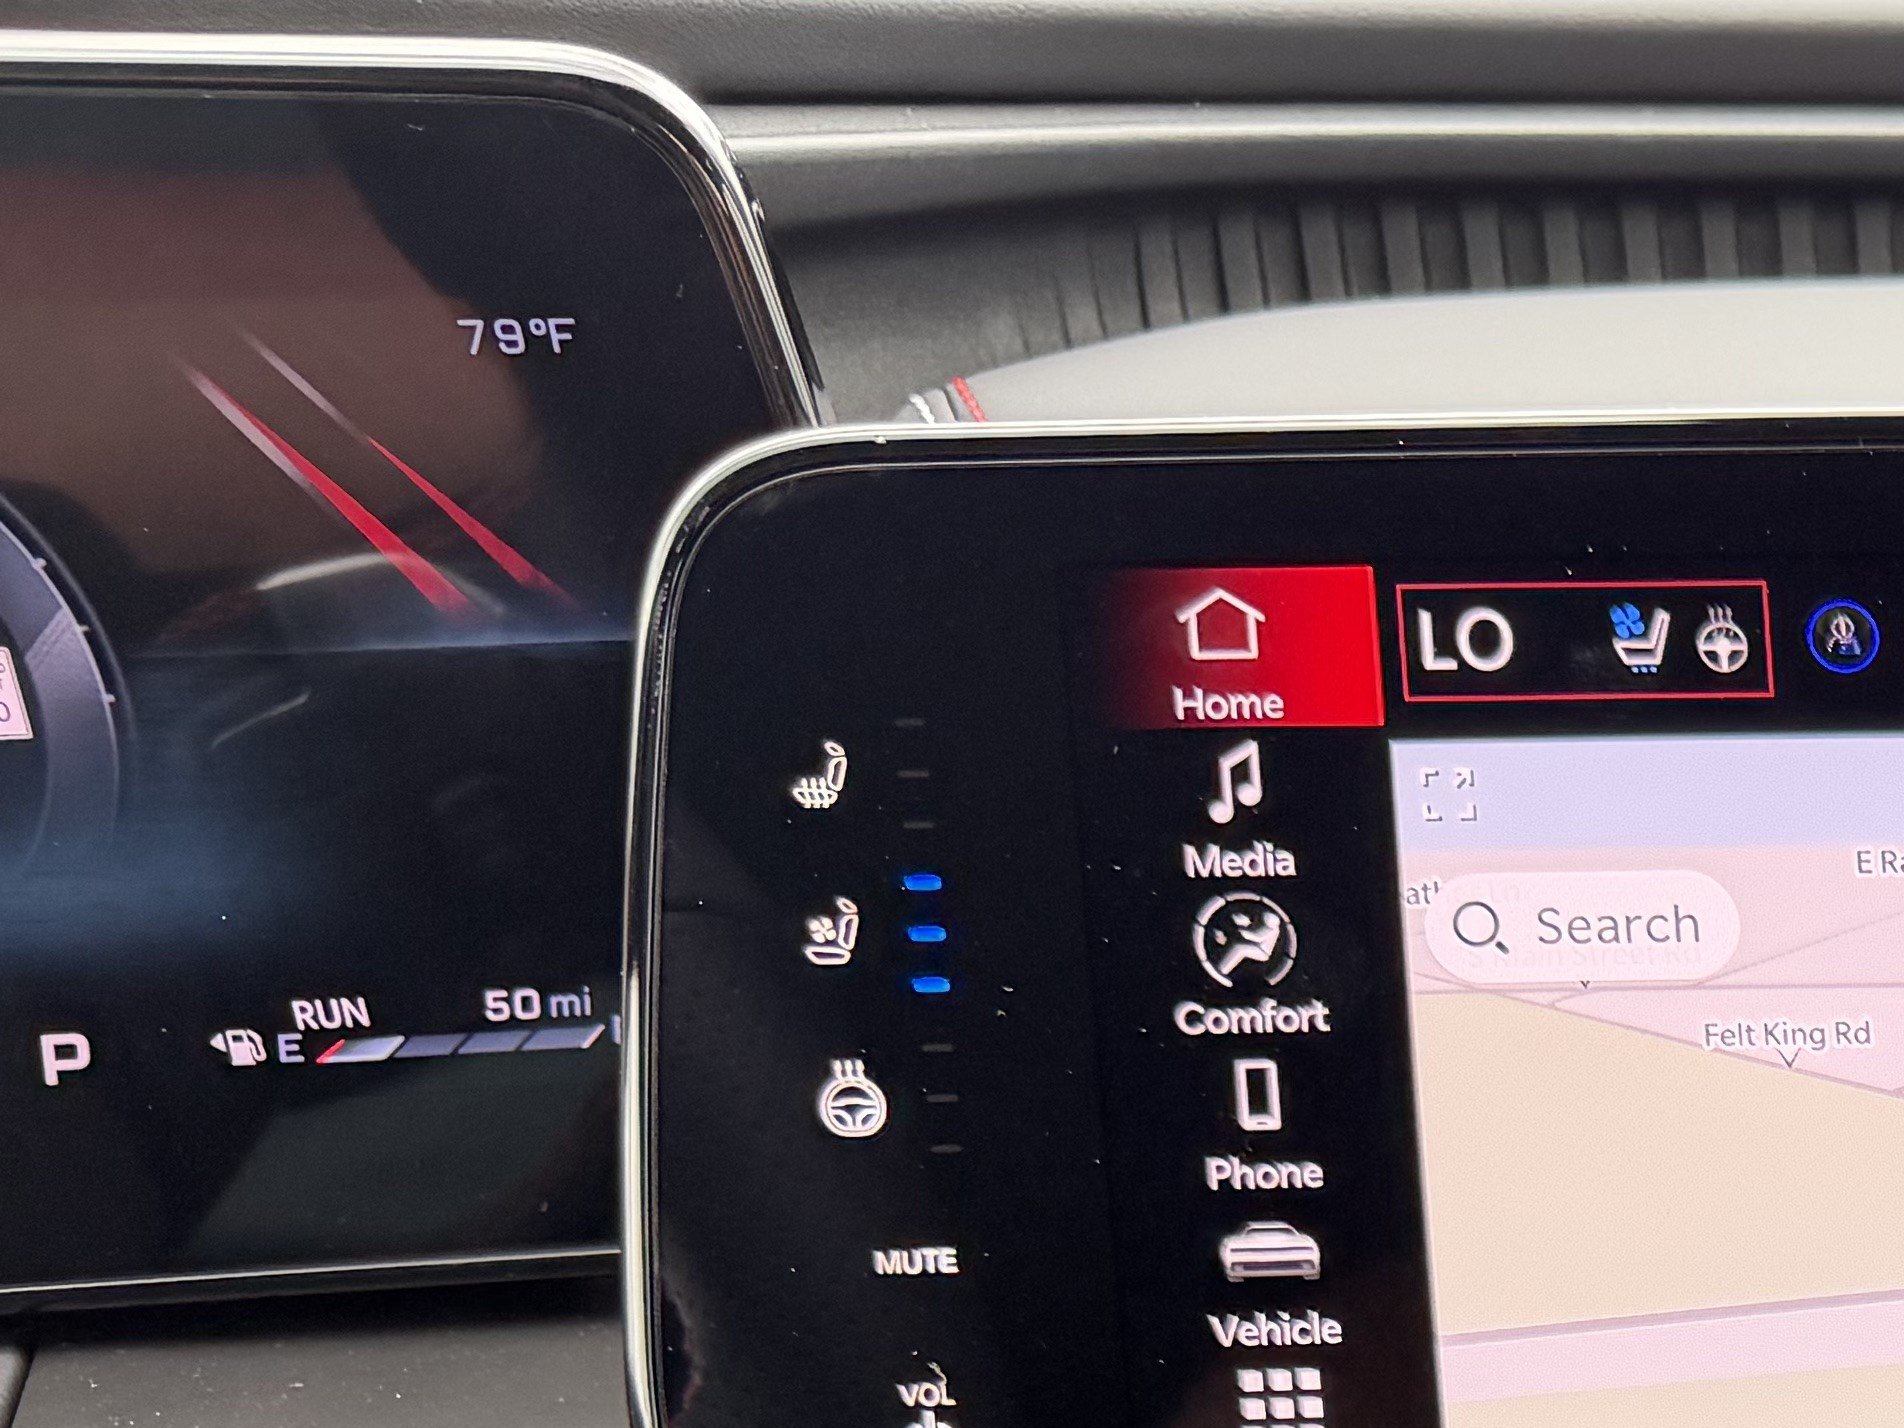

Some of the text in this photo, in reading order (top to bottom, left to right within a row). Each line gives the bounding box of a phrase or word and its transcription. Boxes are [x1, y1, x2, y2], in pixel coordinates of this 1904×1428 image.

[456, 317, 575, 357] 79°F
[1418, 606, 1514, 673] LO
[1172, 687, 1285, 721] Home
[1183, 842, 1297, 879] Media
[1856, 850, 1873, 874] E
[1537, 904, 1701, 945] Search
[291, 998, 371, 1031] RUN
[482, 985, 592, 1022] 50 mi
[1174, 998, 1330, 1037] Comfort
[278, 1031, 305, 1064] E
[1705, 1020, 1872, 1053] Felt King Rd
[41, 1031, 91, 1085] P
[1205, 1157, 1325, 1192] Phone
[873, 1246, 960, 1276] MUTE
[1208, 1310, 1343, 1349] Vehicle
[897, 1379, 956, 1408] VOL
